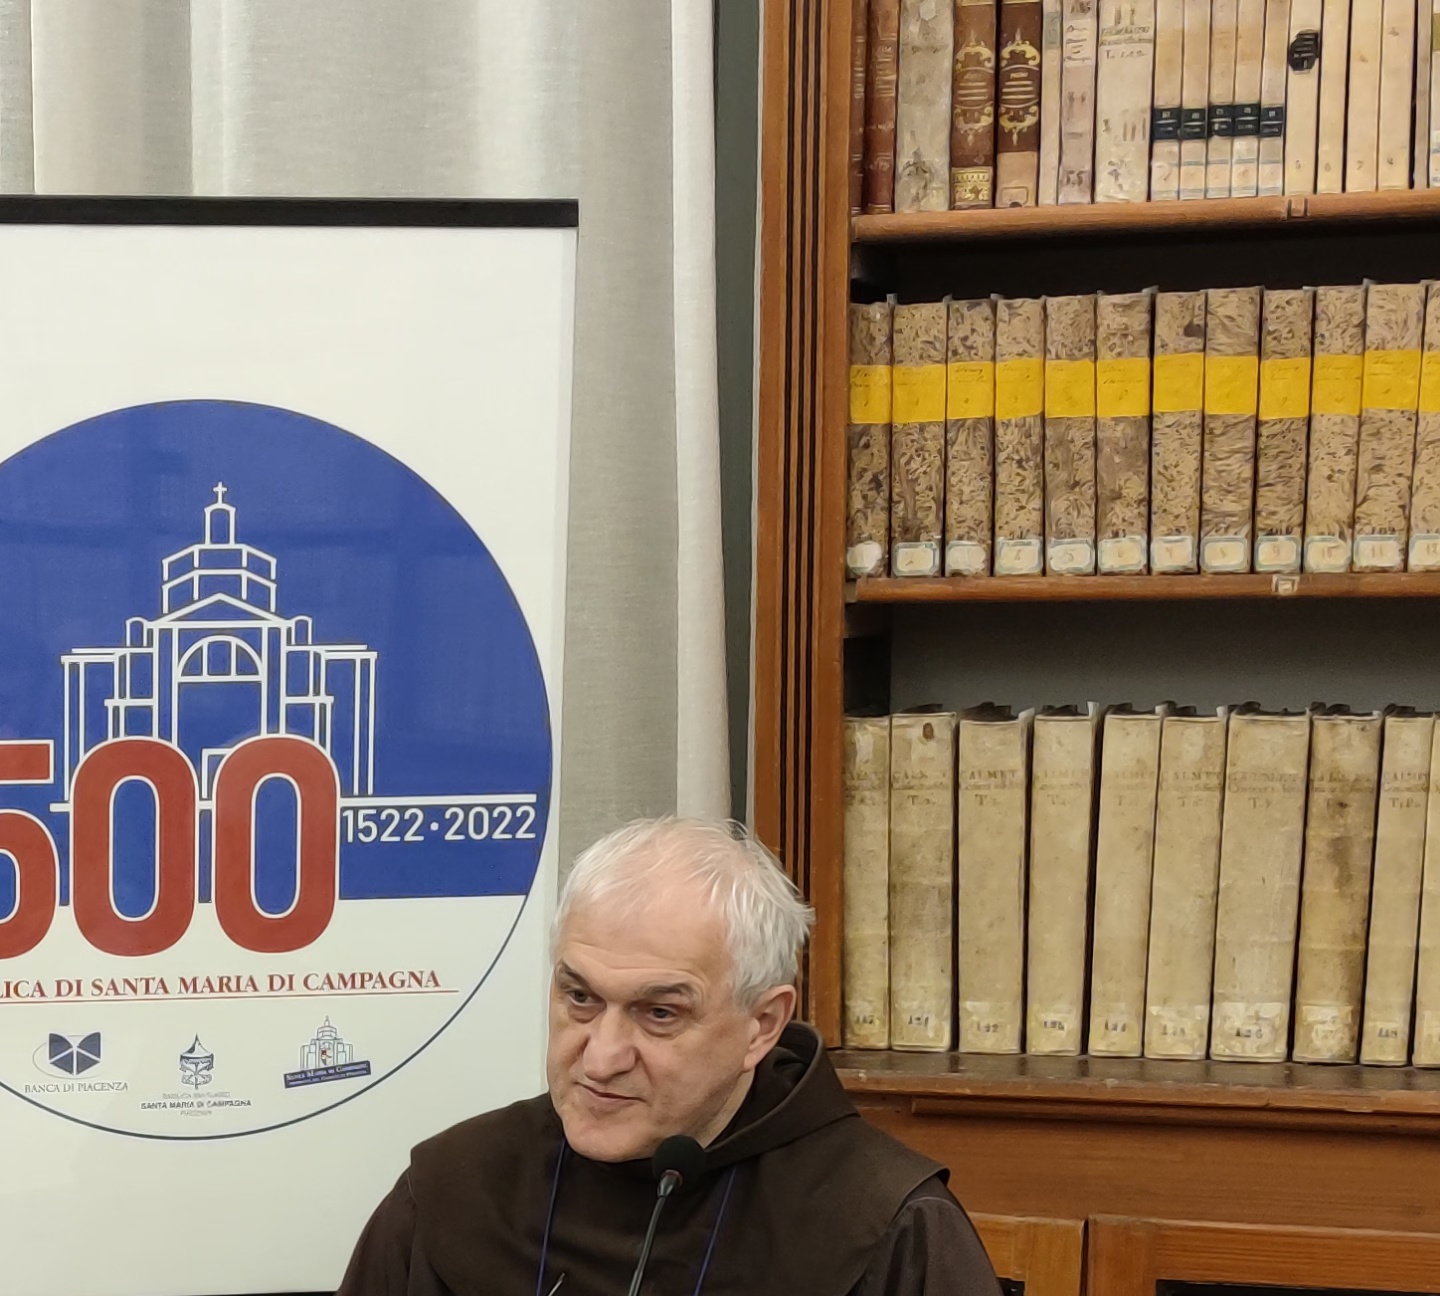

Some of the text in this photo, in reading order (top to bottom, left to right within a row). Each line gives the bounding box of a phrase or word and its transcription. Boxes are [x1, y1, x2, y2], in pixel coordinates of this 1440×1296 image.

[54, 978, 83, 998] DI
[90, 975, 171, 997] SANTA
[176, 973, 259, 995] MARIA
[267, 973, 296, 992] DI
[302, 968, 442, 991] CAMPAGNA
[24, 1081, 129, 1094] BANCA DI PIACENZA
[140, 1102, 167, 1110] SANTA
[169, 1101, 195, 1109] MARIA
[206, 1099, 253, 1108] CAMPAGNA
